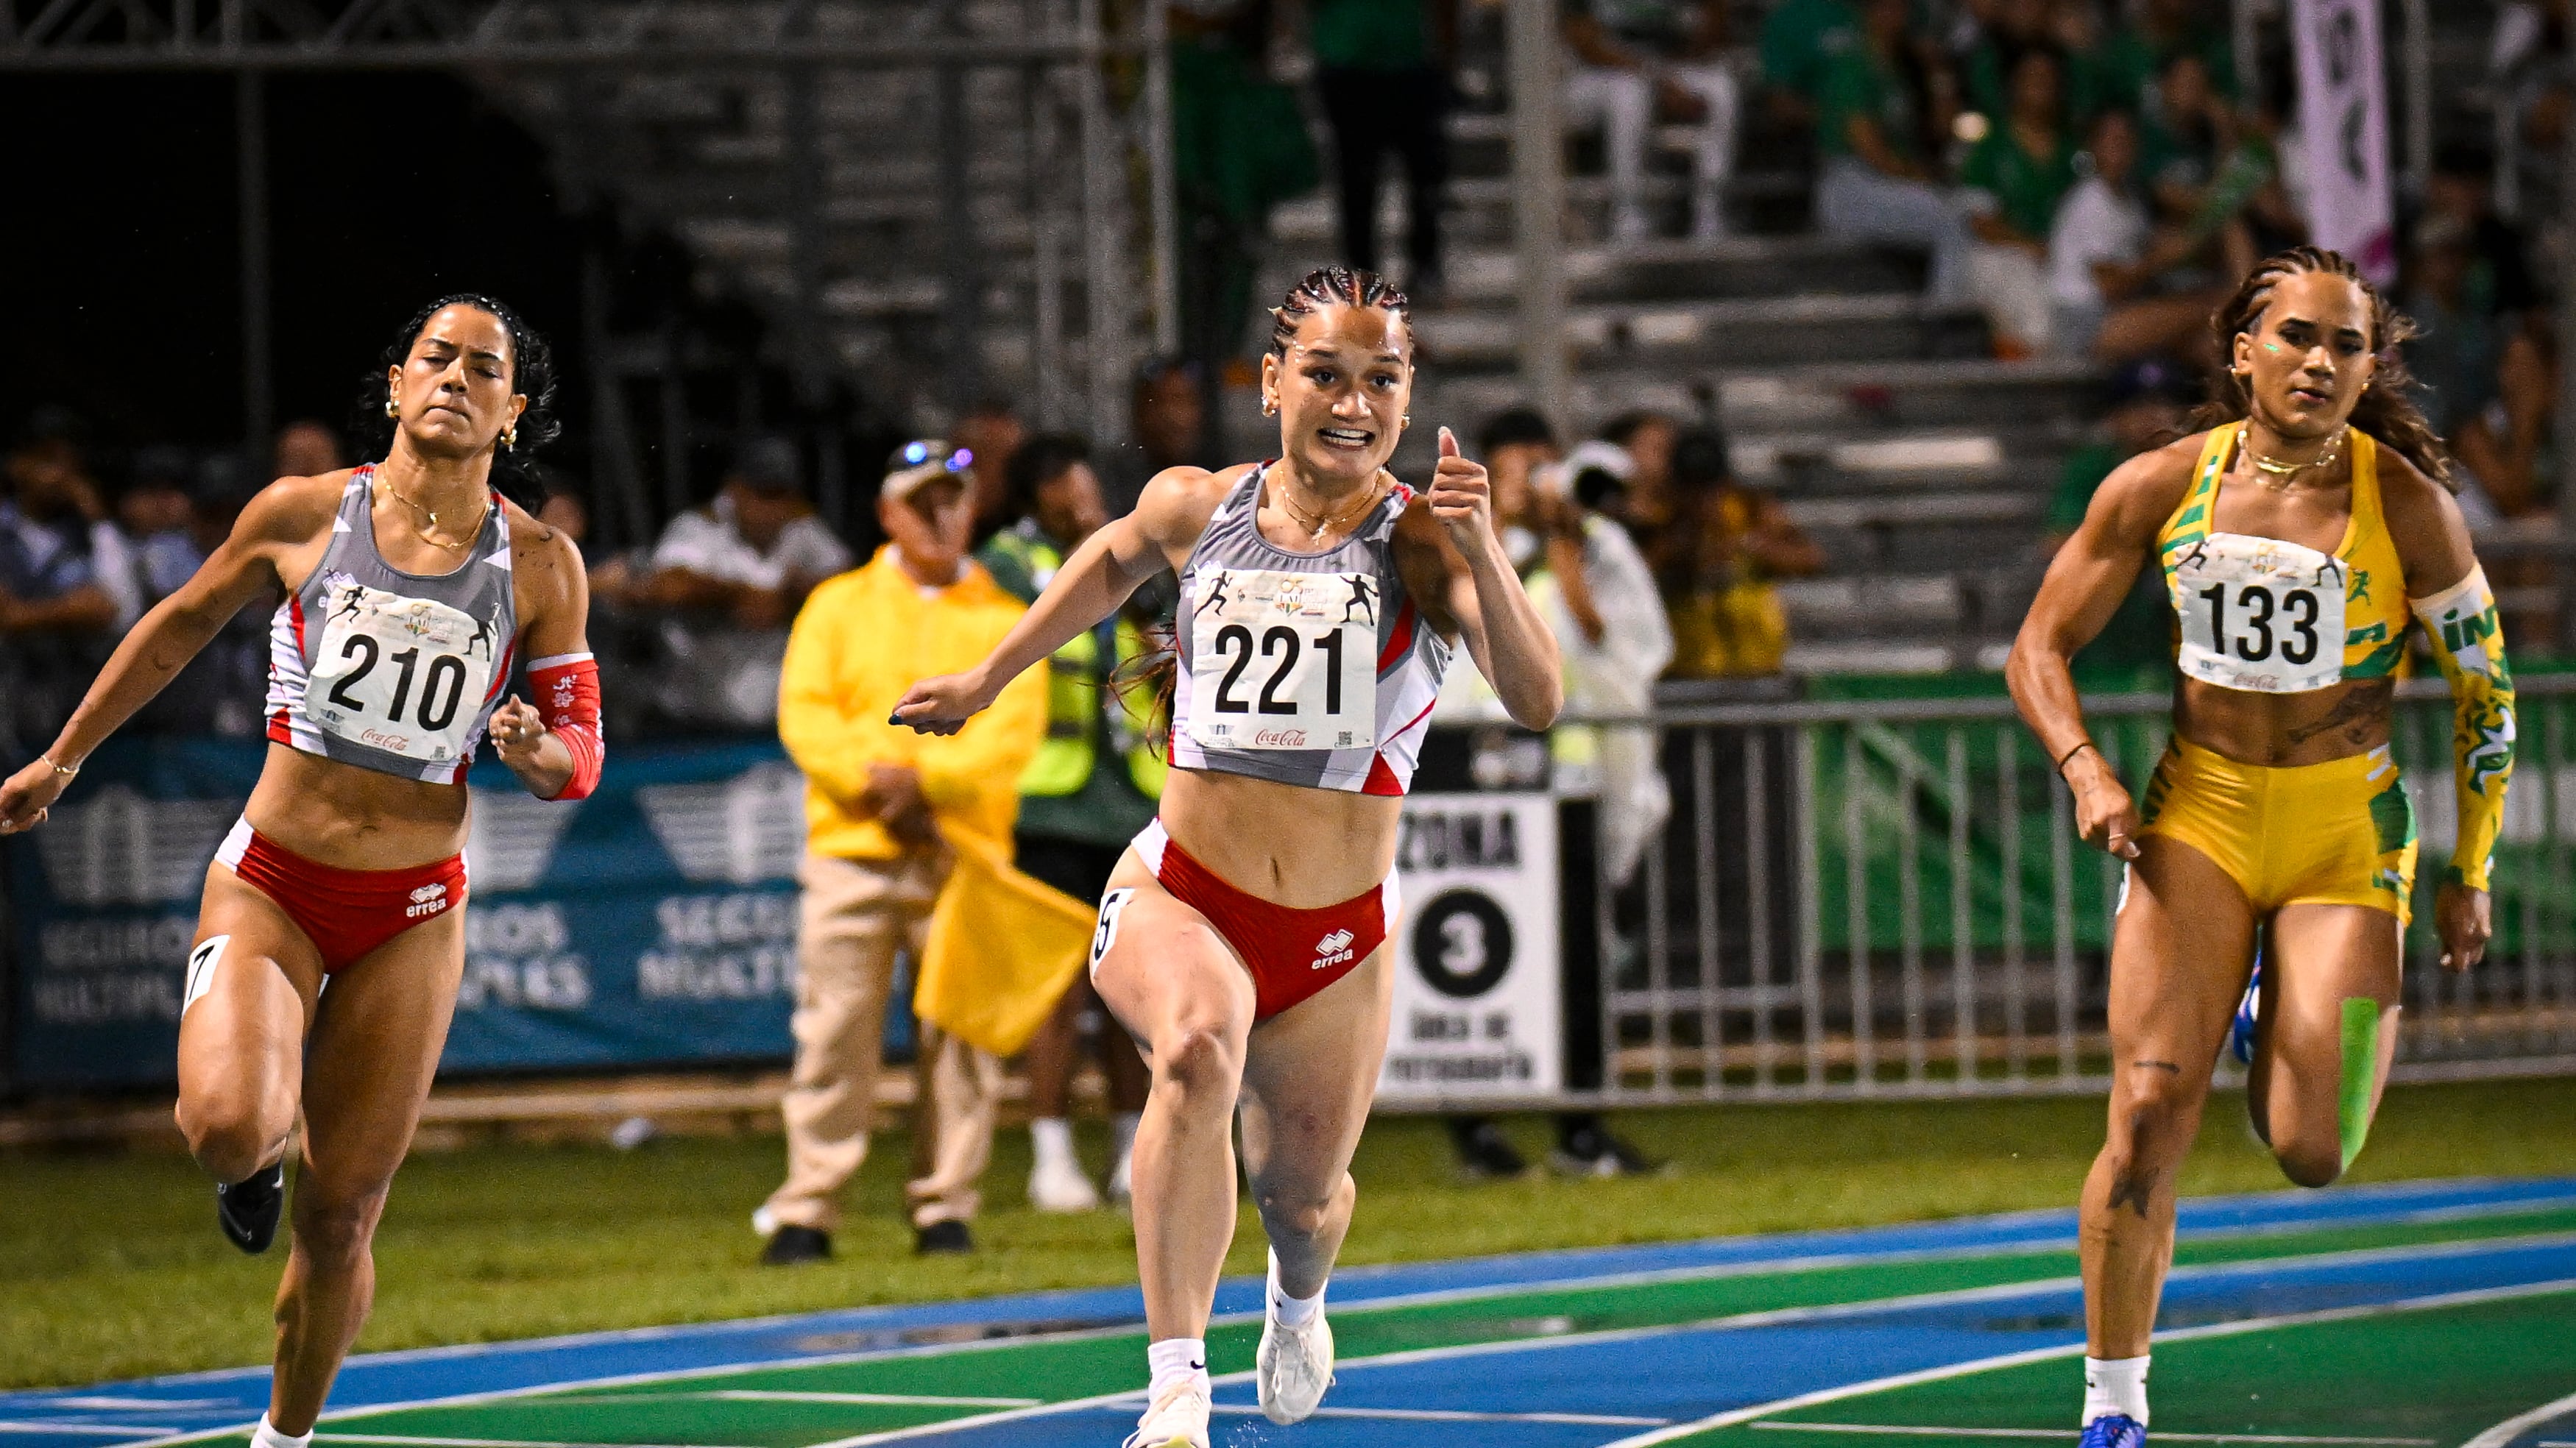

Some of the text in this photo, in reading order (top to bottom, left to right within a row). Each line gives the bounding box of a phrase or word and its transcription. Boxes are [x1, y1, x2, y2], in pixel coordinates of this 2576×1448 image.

[2199, 582, 2319, 665] 133
[328, 634, 467, 731] 210
[1214, 625, 1342, 716] 221
[1094, 892, 1120, 961] 5
[1440, 912, 1488, 977] 3
[188, 944, 216, 1002] 7
